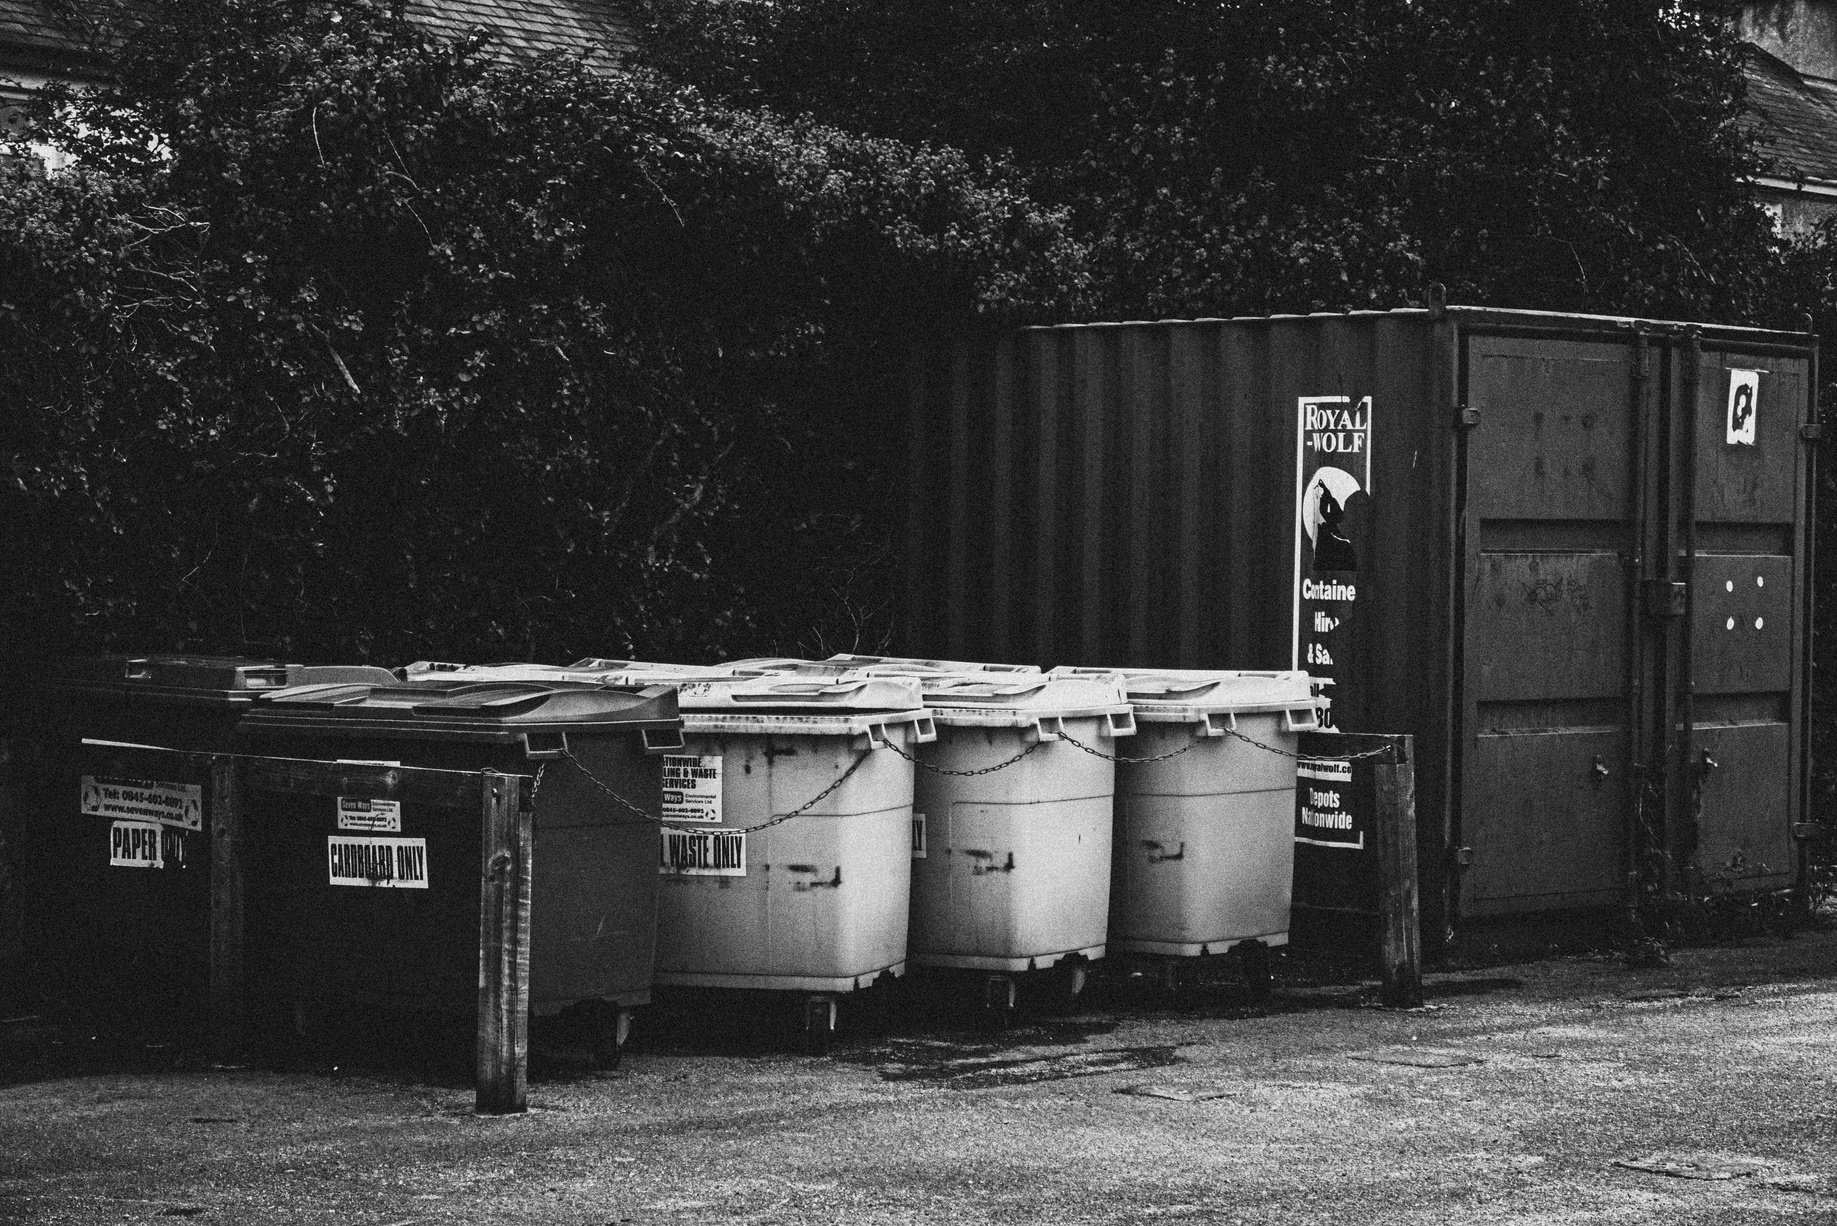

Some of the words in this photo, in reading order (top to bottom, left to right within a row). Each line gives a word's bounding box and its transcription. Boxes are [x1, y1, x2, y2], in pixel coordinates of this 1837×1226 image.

[1305, 404, 1367, 430] ROYAL
[1315, 643, 1333, 665] Sa
[682, 767, 690, 778] &
[691, 768, 717, 779] WASTE
[103, 787, 120, 800] Tel:
[664, 793, 683, 804] Ways
[113, 827, 157, 861] PAPER
[669, 834, 709, 869] WASTE
[713, 834, 743, 869] ONLY
[330, 843, 393, 880] CARDBOARD
[396, 845, 424, 881] ONLY
